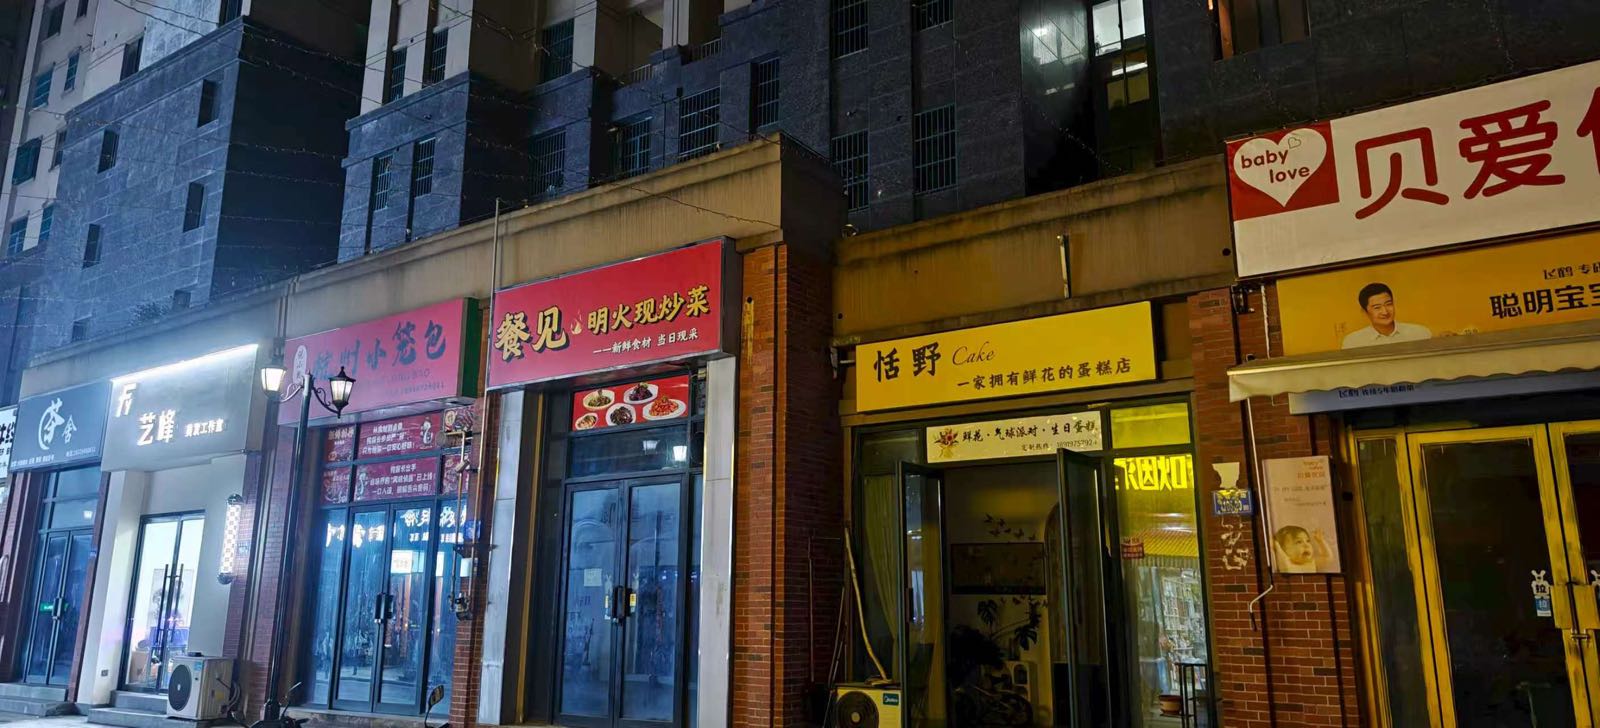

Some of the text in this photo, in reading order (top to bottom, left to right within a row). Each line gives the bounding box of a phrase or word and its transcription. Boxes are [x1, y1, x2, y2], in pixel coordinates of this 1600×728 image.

[1241, 147, 1290, 169] baby
[1269, 163, 1311, 185] love
[1543, 265, 1574, 280] 飞鹤
[495, 285, 711, 361] 餐见 明火现炒菜
[656, 327, 699, 347] 当日现采
[873, 341, 942, 384] 恬野
[952, 340, 997, 367] Cake
[957, 357, 1132, 391] 一家拥有鲜花的蛋糕店
[136, 408, 177, 447] 艺峰
